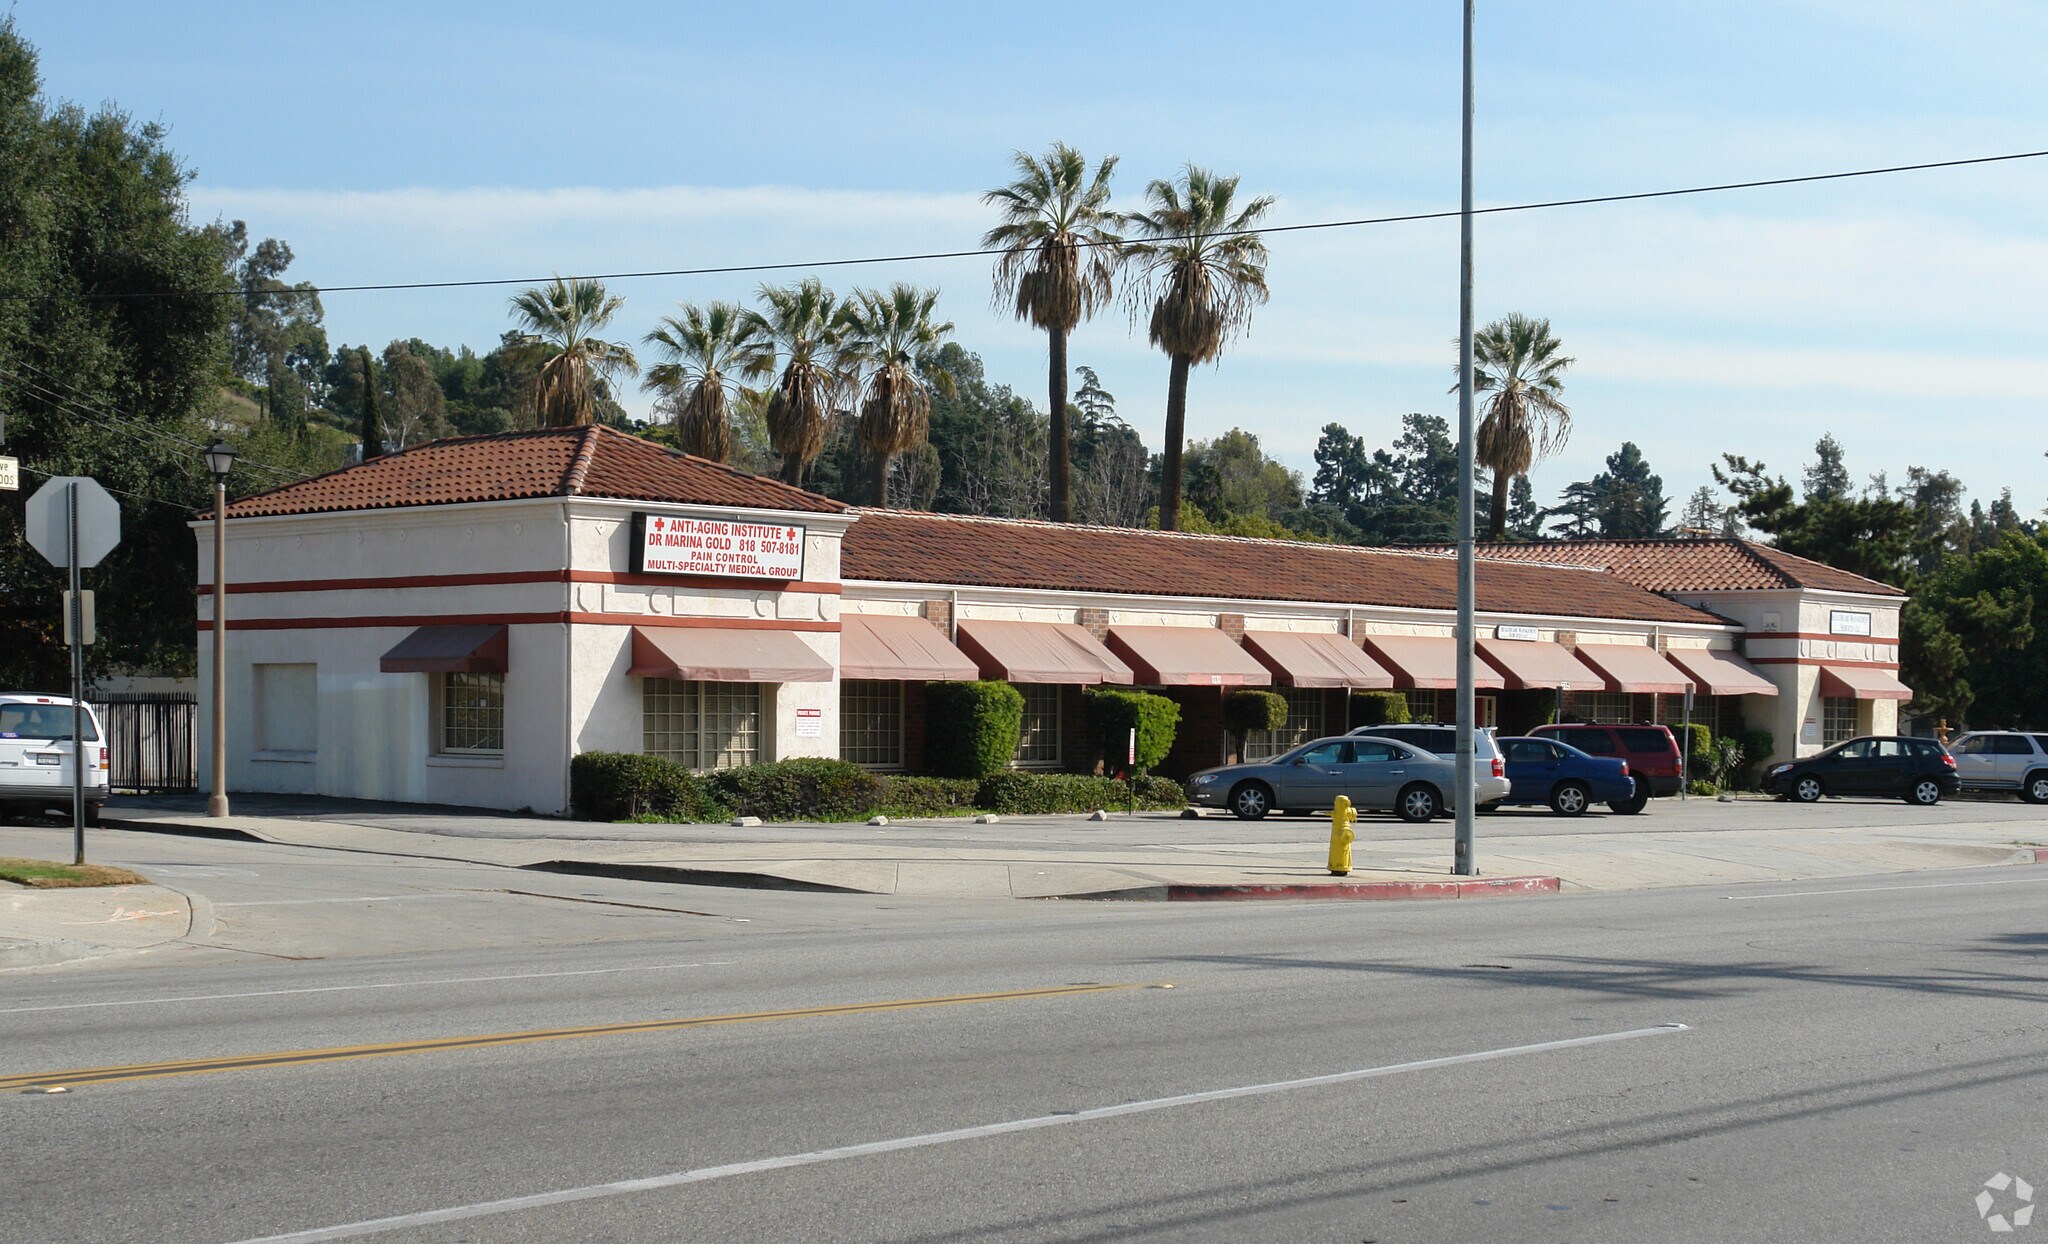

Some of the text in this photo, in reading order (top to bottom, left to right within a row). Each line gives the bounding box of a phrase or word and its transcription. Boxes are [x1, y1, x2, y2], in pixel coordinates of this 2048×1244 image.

[670, 519, 782, 540] ANTI-AGING INSTITUTE
[649, 533, 799, 556] DR MARINA GOLD 818 507-8181
[691, 551, 758, 564] PAIN CONTROL
[647, 560, 798, 578] MULTI-SPECIALTY MEDICAL GROUP
